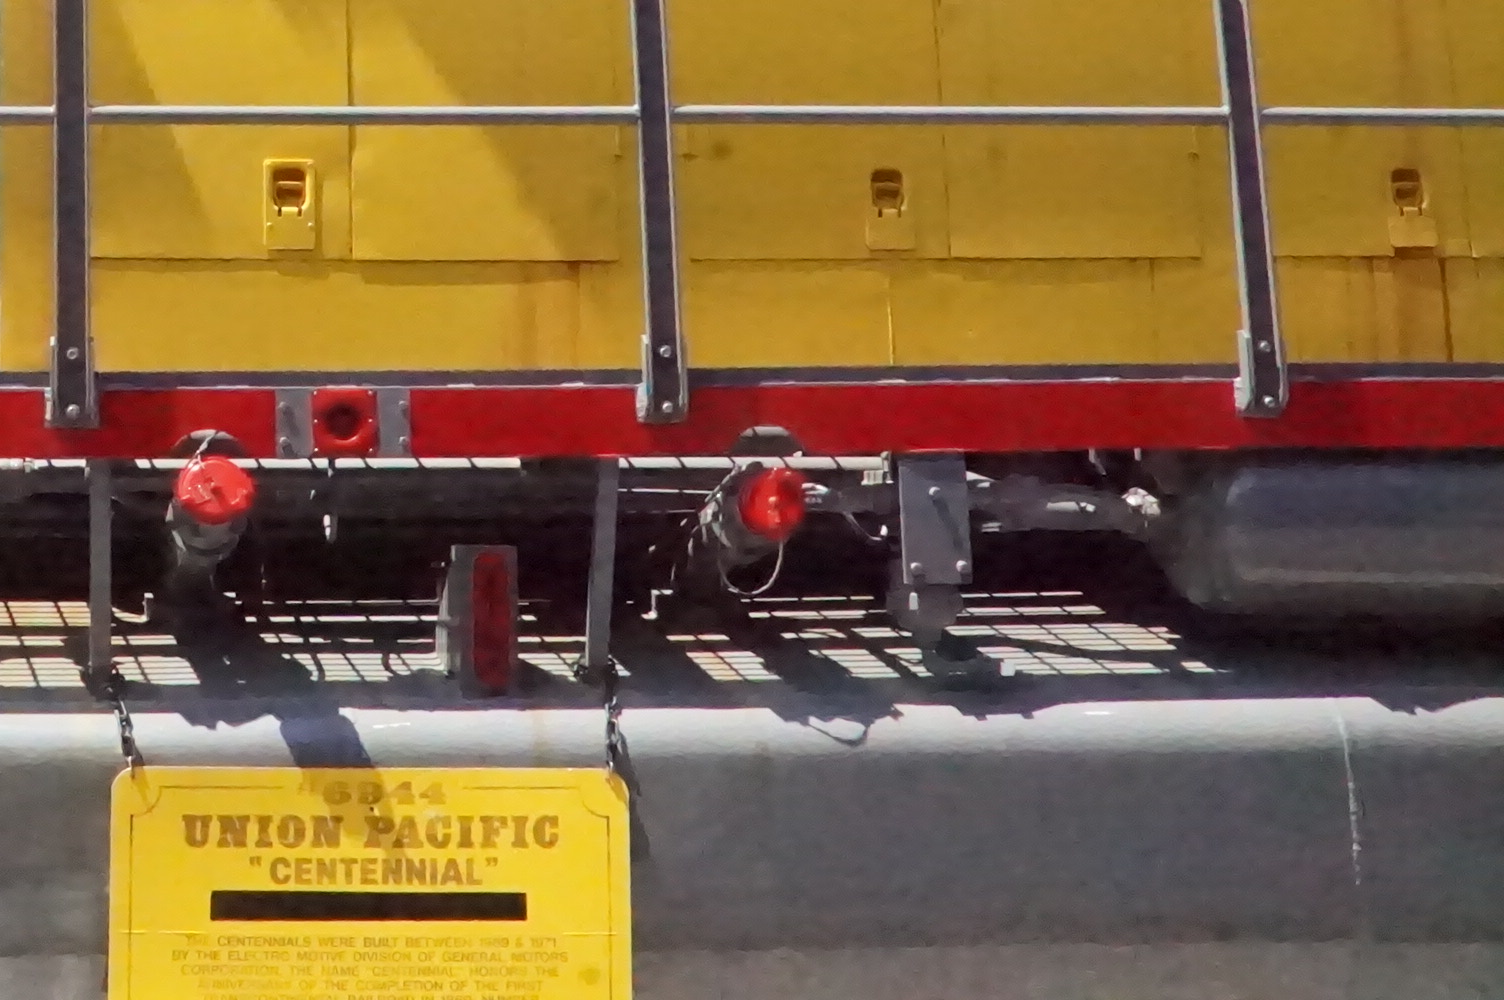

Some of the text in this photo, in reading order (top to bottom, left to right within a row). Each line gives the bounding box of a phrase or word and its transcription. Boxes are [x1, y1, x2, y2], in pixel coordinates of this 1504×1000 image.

[182, 813, 560, 850] UNION PACIFIC
[217, 935, 312, 948] CENTENNIALS
[318, 935, 355, 948] WERE
[363, 936, 399, 948] BUILT
[196, 950, 221, 961] THE
[353, 951, 412, 962] DIVISION
[417, 951, 436, 962] OF
[442, 951, 503, 963] GENERAL
[290, 965, 313, 976] THE
[535, 966, 560, 978] THE
[323, 980, 347, 991] THE
[449, 980, 468, 991] OF
